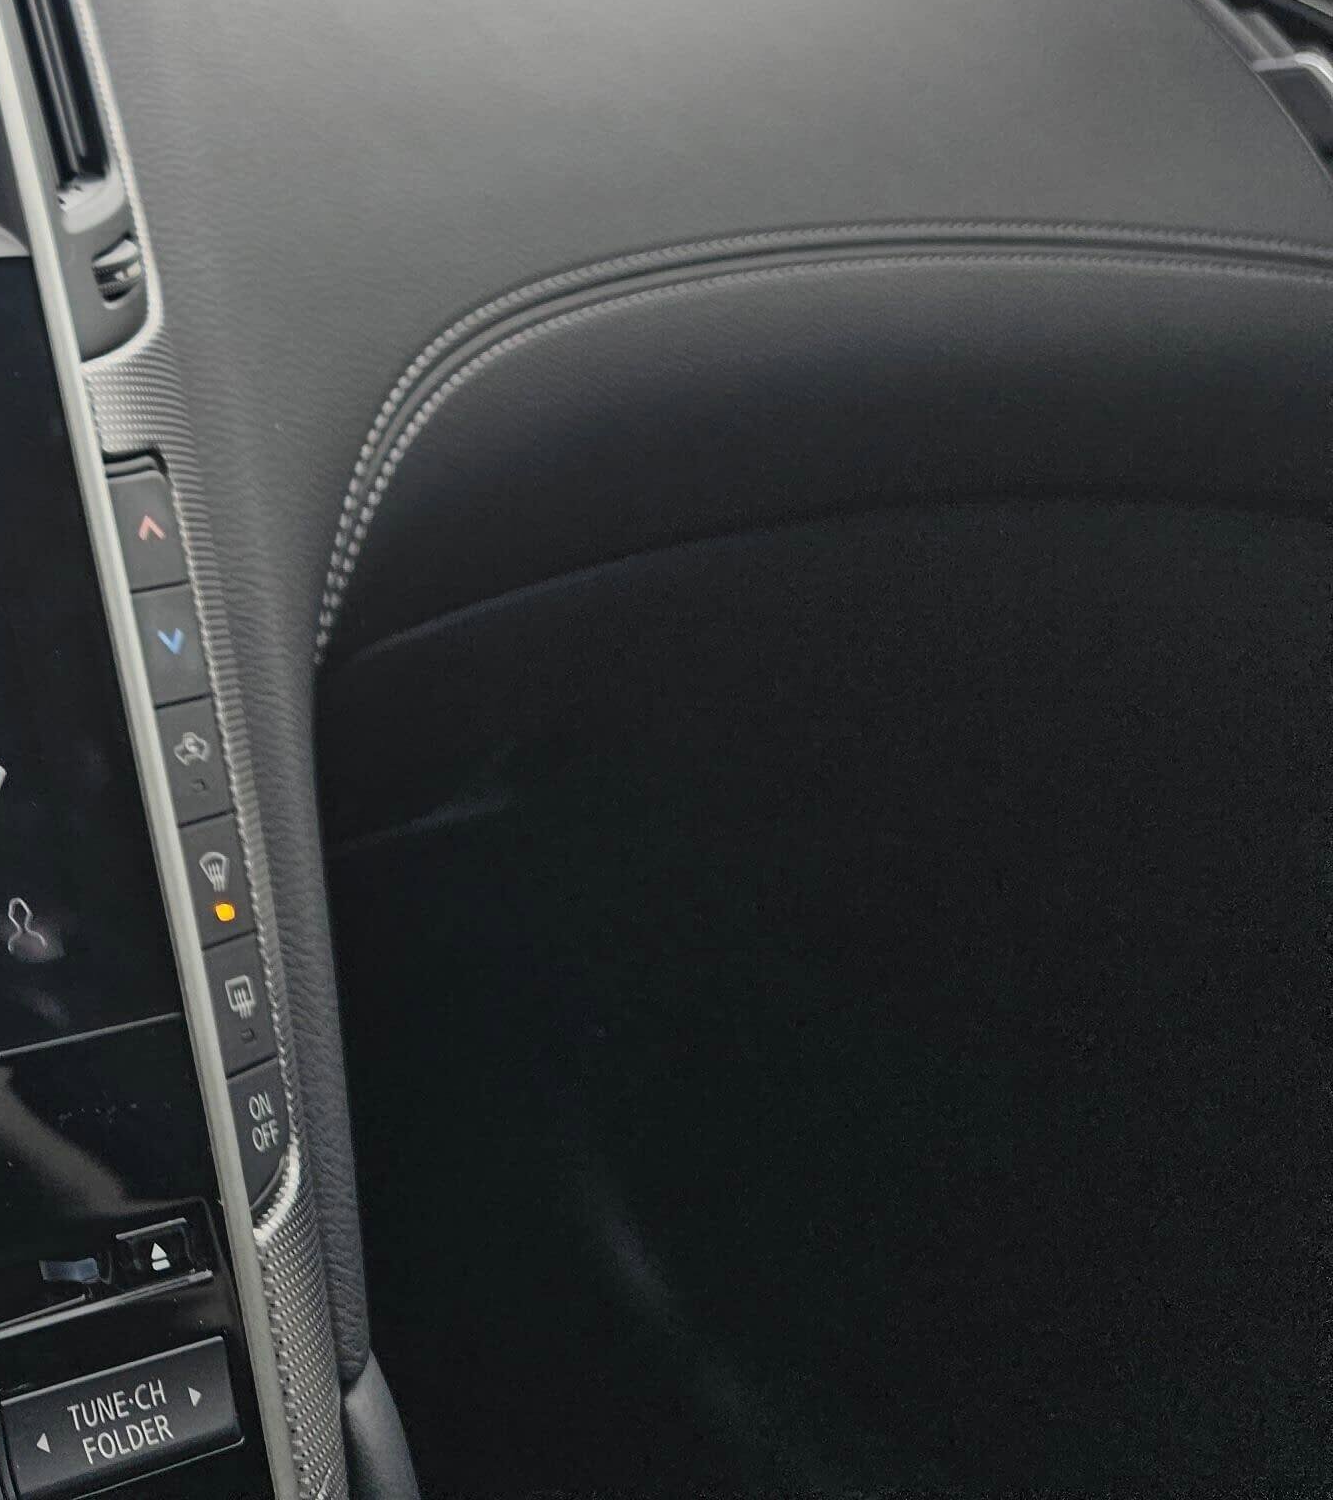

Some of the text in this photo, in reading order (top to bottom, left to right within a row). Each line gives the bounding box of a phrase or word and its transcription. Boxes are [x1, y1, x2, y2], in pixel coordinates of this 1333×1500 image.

[249, 1091, 274, 1121] ON
[251, 1119, 279, 1152] OFF
[81, 1414, 173, 1465] FOLDER
